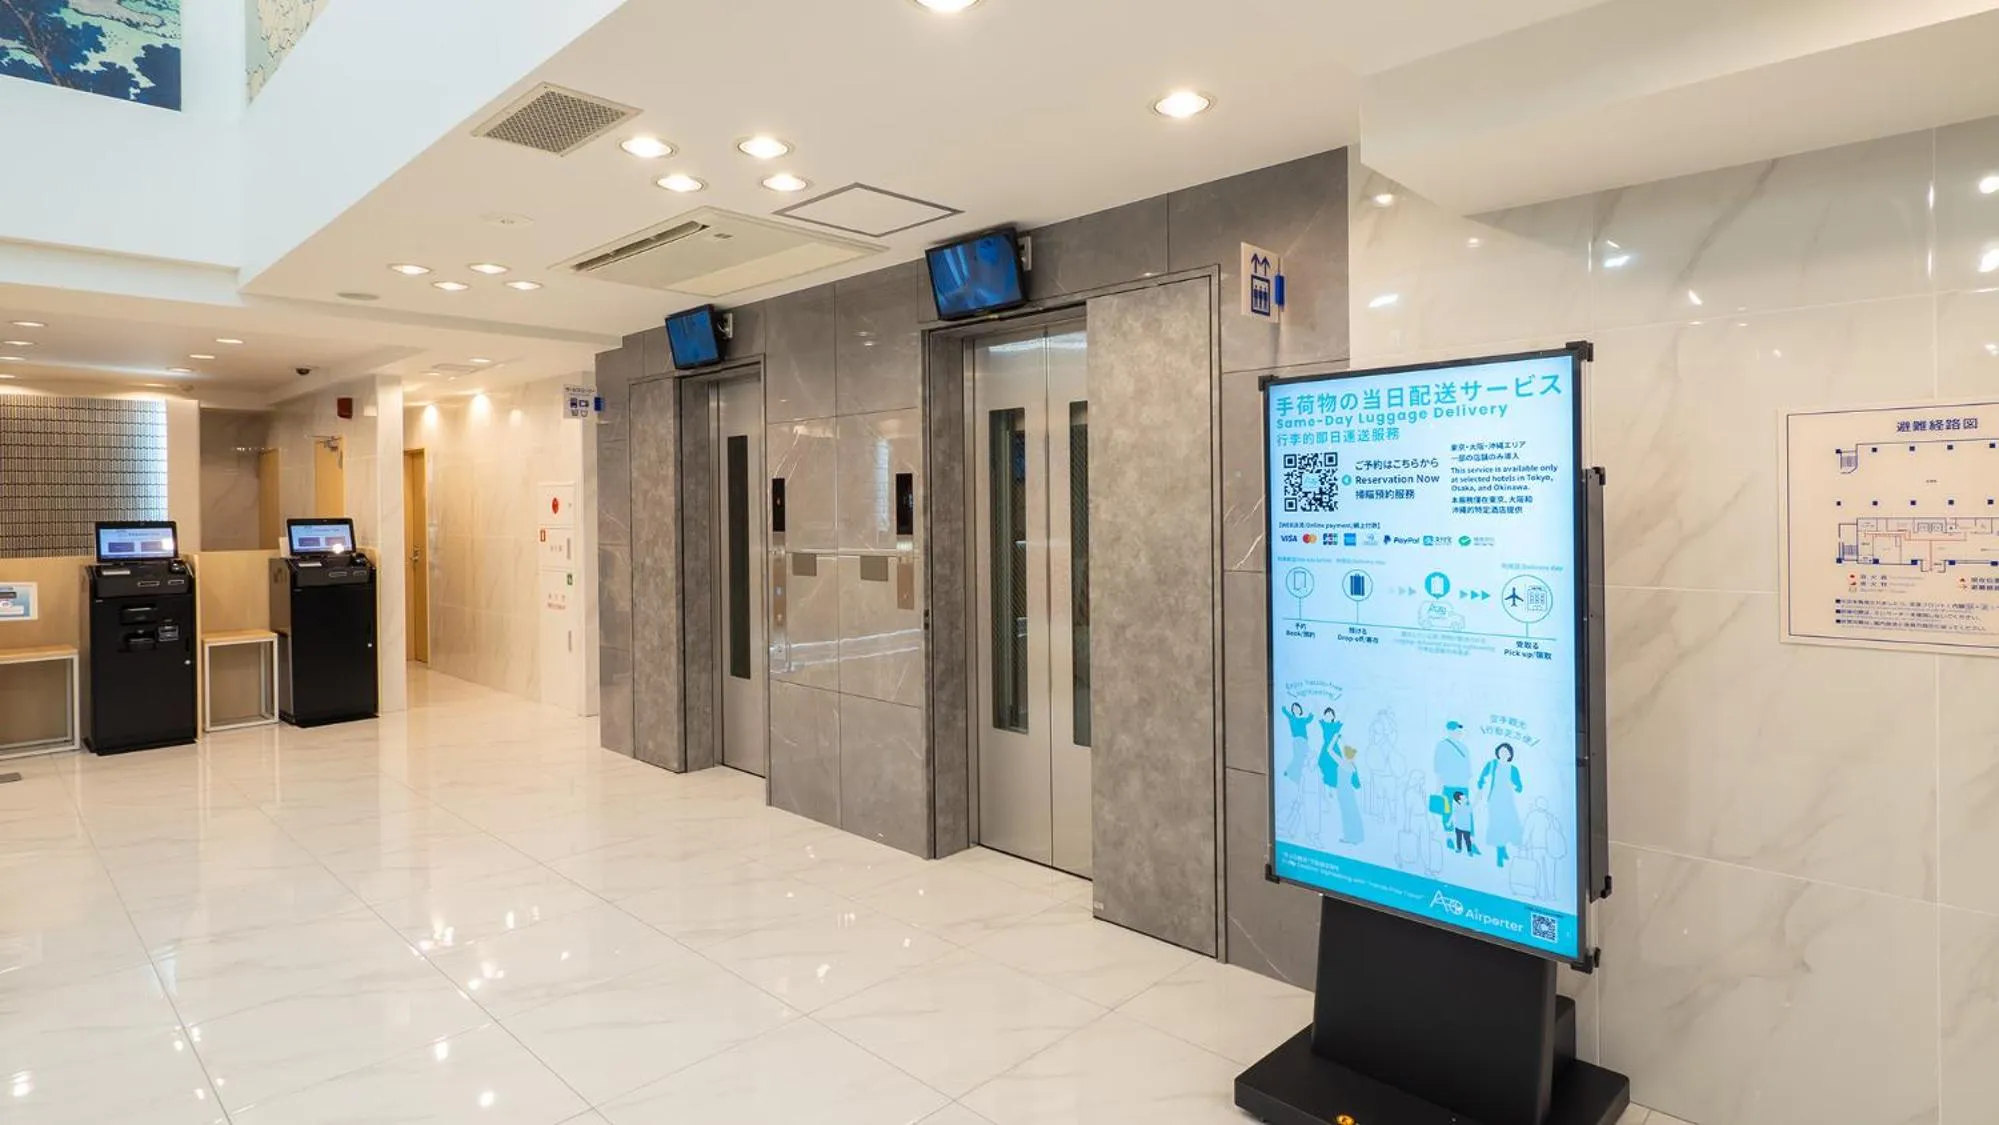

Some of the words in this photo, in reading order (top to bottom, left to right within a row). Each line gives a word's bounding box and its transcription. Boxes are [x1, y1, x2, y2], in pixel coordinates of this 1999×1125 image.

[1276, 374, 1562, 417] 手荷物の当日配送サービス
[1276, 413, 1353, 430] Same-Day
[1359, 408, 1427, 426] Luggage
[1433, 403, 1508, 418] Delivery
[1897, 418, 1978, 433] 避難経路図
[1277, 428, 1400, 447] 行李的即日運送服務
[1355, 458, 1439, 471] ご予約はこちらから
[1467, 466, 1493, 474] service
[1503, 465, 1538, 473] available
[1539, 464, 1558, 473] only
[1355, 474, 1414, 485] Reservation
[1416, 474, 1440, 484] Now
[1460, 475, 1491, 483] selected
[1527, 474, 1554, 483] Tokyo,
[1280, 534, 1298, 543] VISA
[1393, 536, 1420, 545] PayPal
[1465, 908, 1524, 933] Airporter
